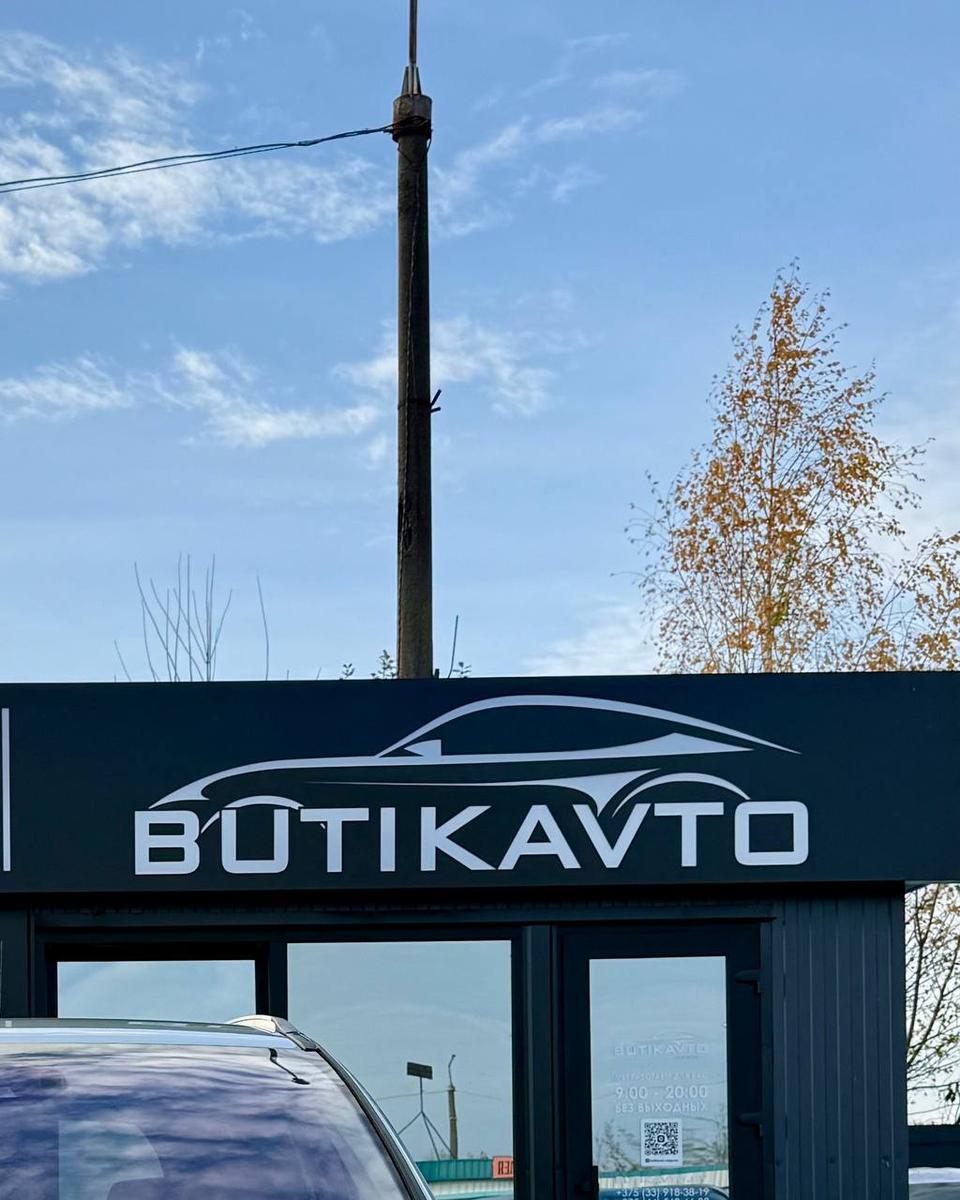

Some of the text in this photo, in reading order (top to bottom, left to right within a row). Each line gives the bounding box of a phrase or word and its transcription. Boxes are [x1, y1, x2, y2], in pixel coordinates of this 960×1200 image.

[134, 800, 809, 876] BUTIKAVTO
[665, 1086, 709, 1099] 20:00
[615, 1101, 708, 1114] БЕЗ ВЫХОДНЫХ
[616, 1188, 640, 1197] +375
